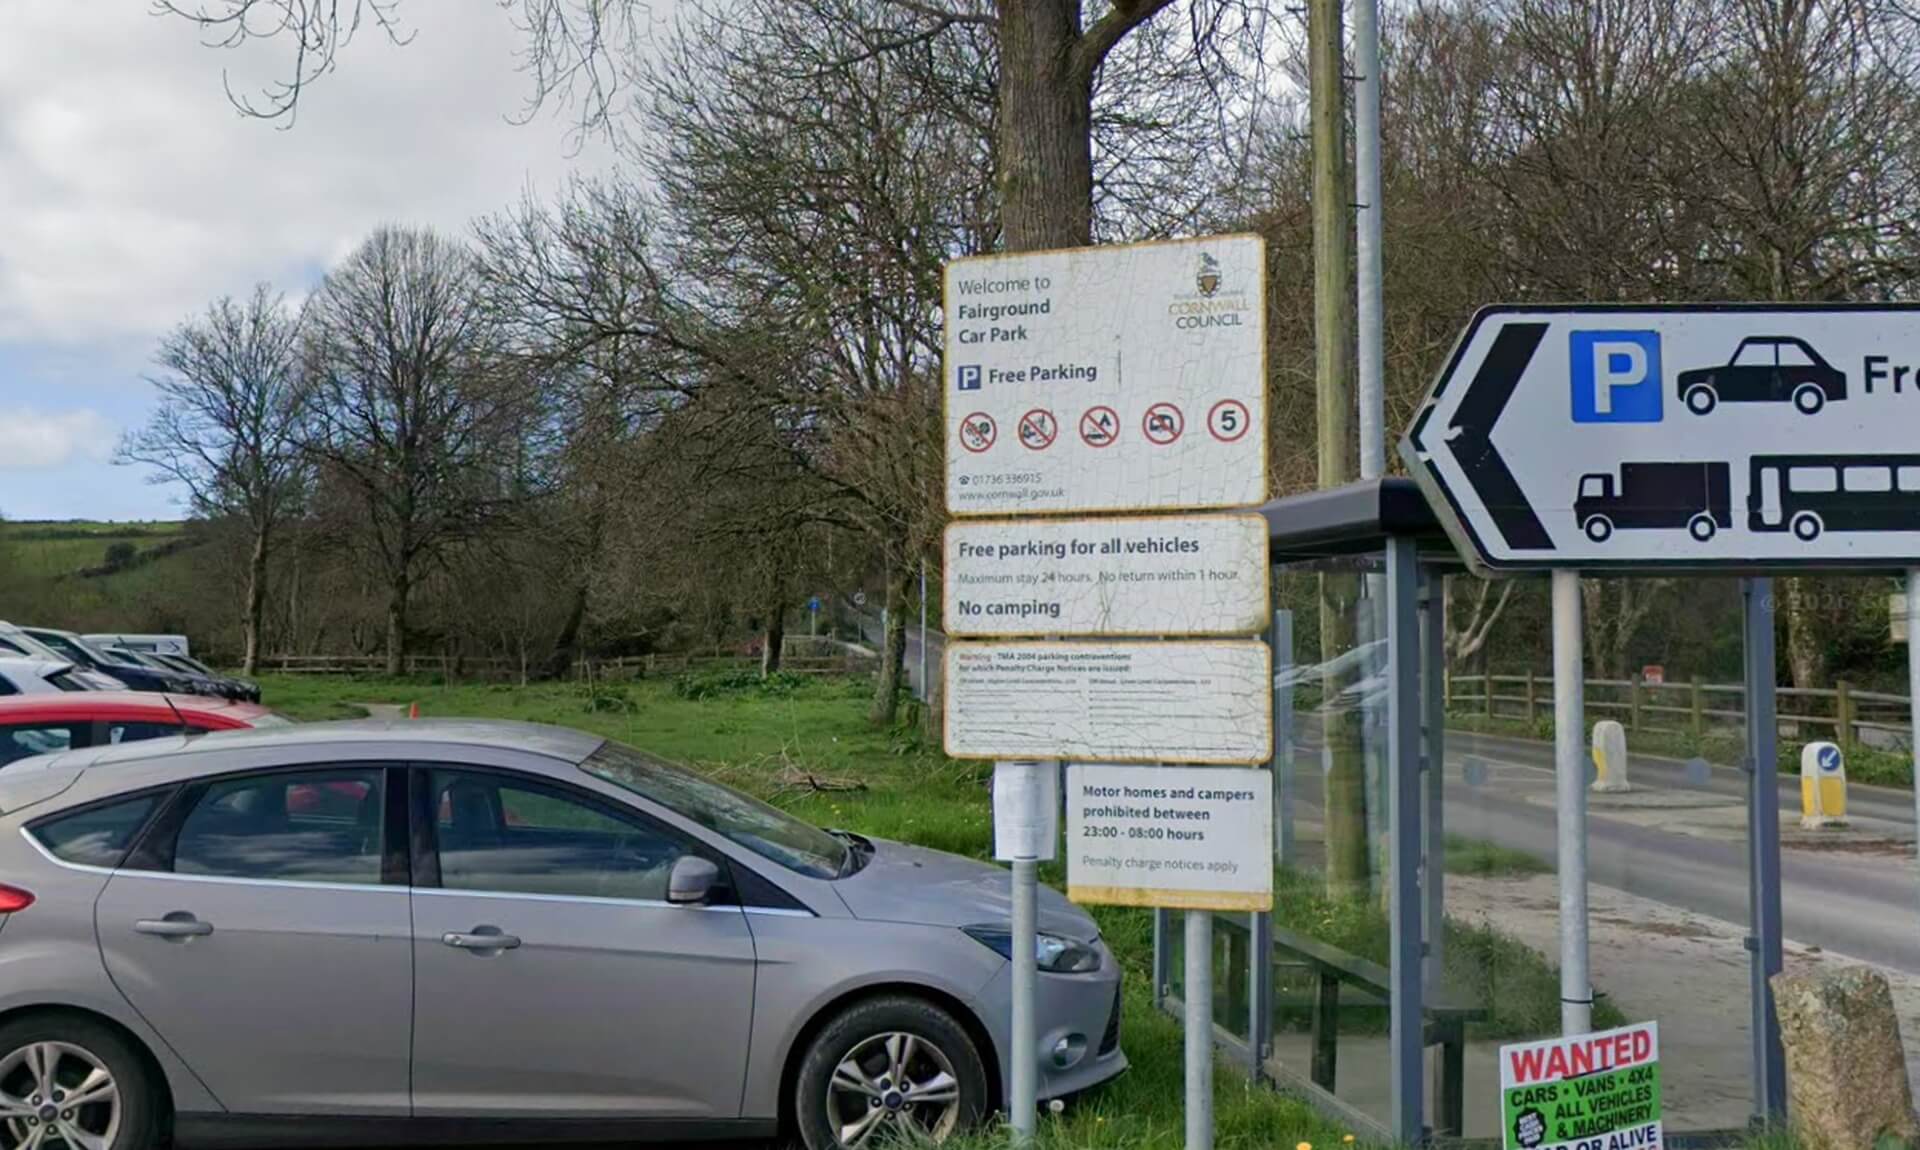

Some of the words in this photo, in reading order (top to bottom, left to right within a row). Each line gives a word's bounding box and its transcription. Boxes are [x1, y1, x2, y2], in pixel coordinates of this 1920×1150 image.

[959, 280, 1031, 295] Welcome
[1035, 276, 1051, 290] to
[959, 300, 1051, 321] Fairground
[1169, 299, 1250, 315] CORNWALL
[1176, 313, 1243, 329] COUNCIL
[959, 329, 986, 344] Car
[991, 326, 1027, 342] Park
[961, 366, 977, 387] P
[989, 367, 1026, 384] Free
[1031, 364, 1097, 383] Parking
[1592, 341, 1648, 413] P
[1220, 410, 1237, 432] 5
[959, 543, 995, 558] Free
[999, 540, 1066, 560] parking
[1071, 539, 1097, 555] for
[1101, 538, 1122, 554] all
[1126, 537, 1200, 553] vehicles
[959, 572, 1012, 584] Maximum
[1016, 572, 1039, 586] stay
[1042, 571, 1055, 583] 24
[1099, 571, 1116, 582] No
[1119, 570, 1155, 582] return
[1158, 569, 1196, 581] within
[959, 601, 984, 615] No
[986, 600, 1061, 618] camping
[1038, 652, 1068, 663] parking
[971, 664, 994, 672] which
[996, 664, 1026, 674] Penalty
[1027, 664, 1055, 674] Charge
[1057, 664, 1087, 672] Notices
[1083, 785, 1121, 798] Motor
[1124, 786, 1166, 799] homes
[1169, 787, 1195, 799] and
[1198, 789, 1254, 802] campers
[1083, 805, 1150, 819] prohibited
[1153, 806, 1210, 820] between
[1083, 825, 1117, 838] 23:00
[1128, 827, 1163, 839] 08:00
[1167, 828, 1204, 840] hours
[1083, 855, 1122, 869] Penalty
[1125, 857, 1161, 870] charge
[1164, 858, 1204, 870] notices
[1207, 860, 1238, 873] apply
[1511, 1029, 1651, 1083] WANTED
[1511, 1086, 1558, 1107] CARS
[1574, 1076, 1615, 1097] VANS
[1555, 1101, 1584, 1120] ALL
[1588, 1086, 1653, 1114] VEHICLES
[1556, 1121, 1568, 1138] &
[1572, 1103, 1654, 1136] MACHINERY
[1610, 1124, 1657, 1150] ALIVE
